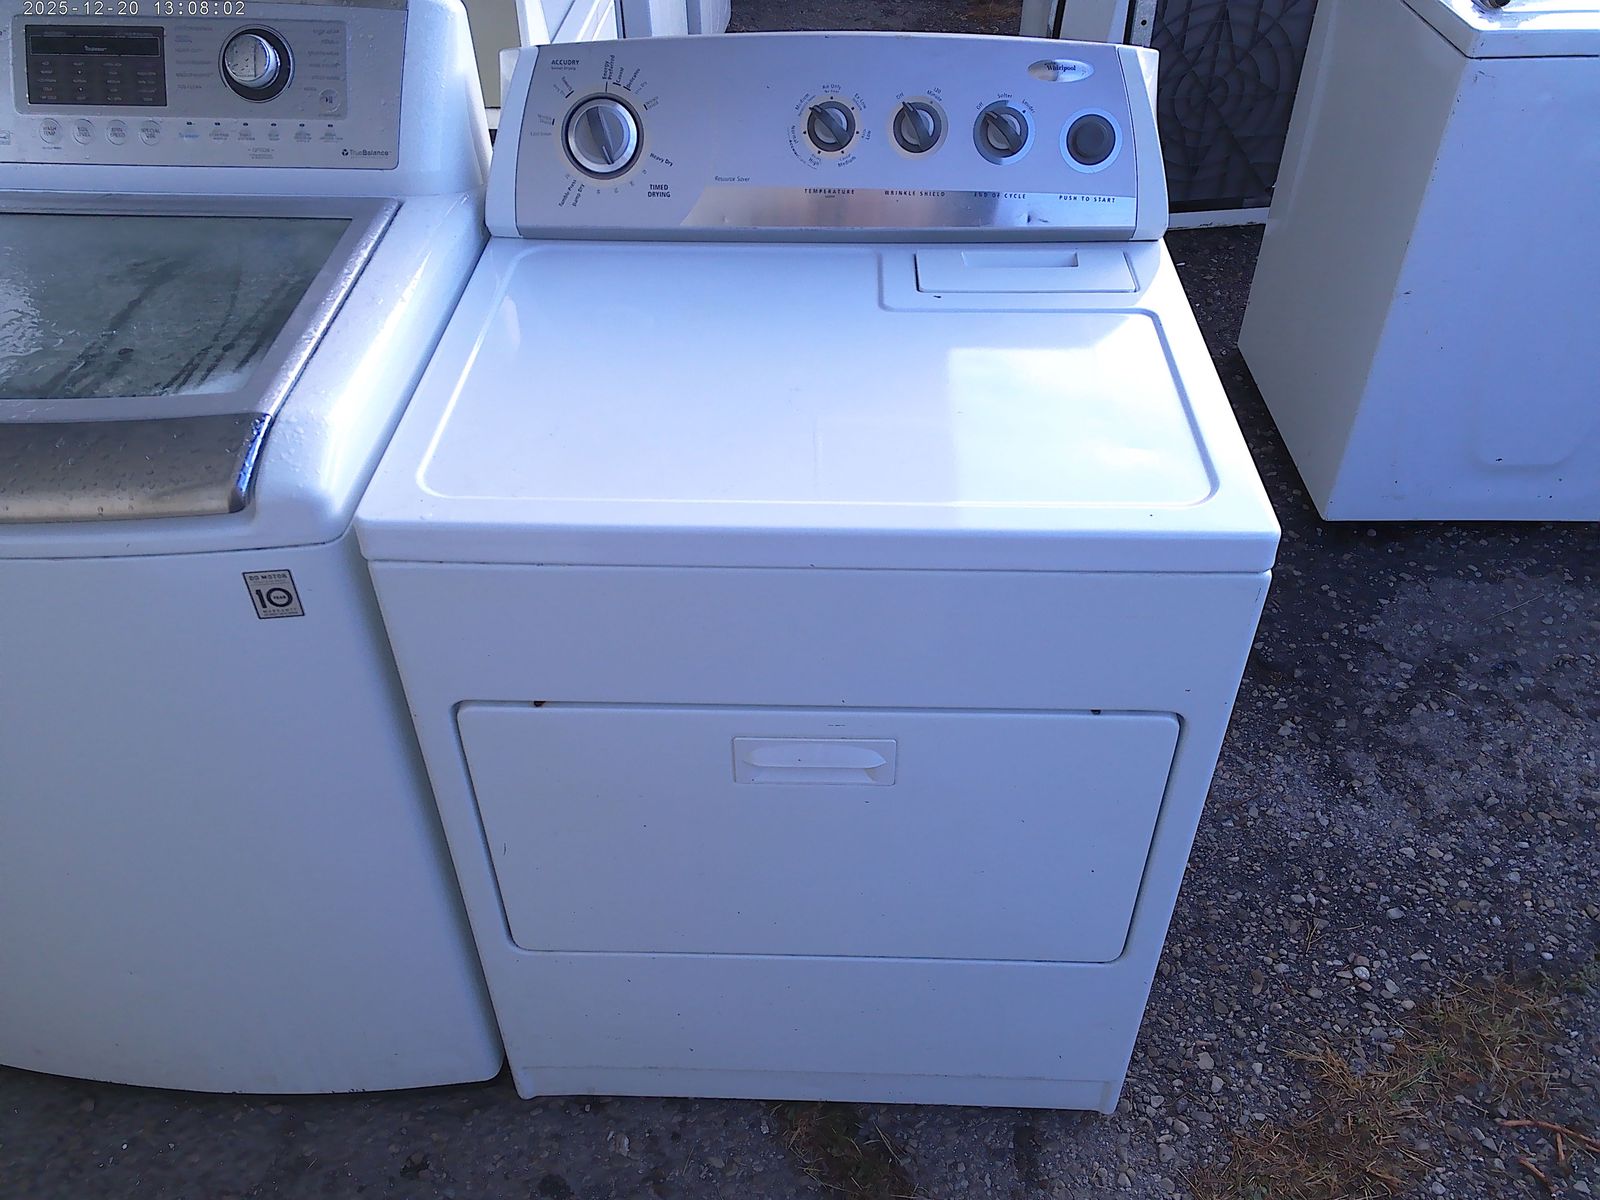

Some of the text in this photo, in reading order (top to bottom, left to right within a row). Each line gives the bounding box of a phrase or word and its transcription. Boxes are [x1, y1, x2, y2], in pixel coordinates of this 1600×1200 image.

[602, 60, 611, 80] Energy
[1045, 63, 1076, 72] Whirlpool
[255, 587, 293, 608] 10
